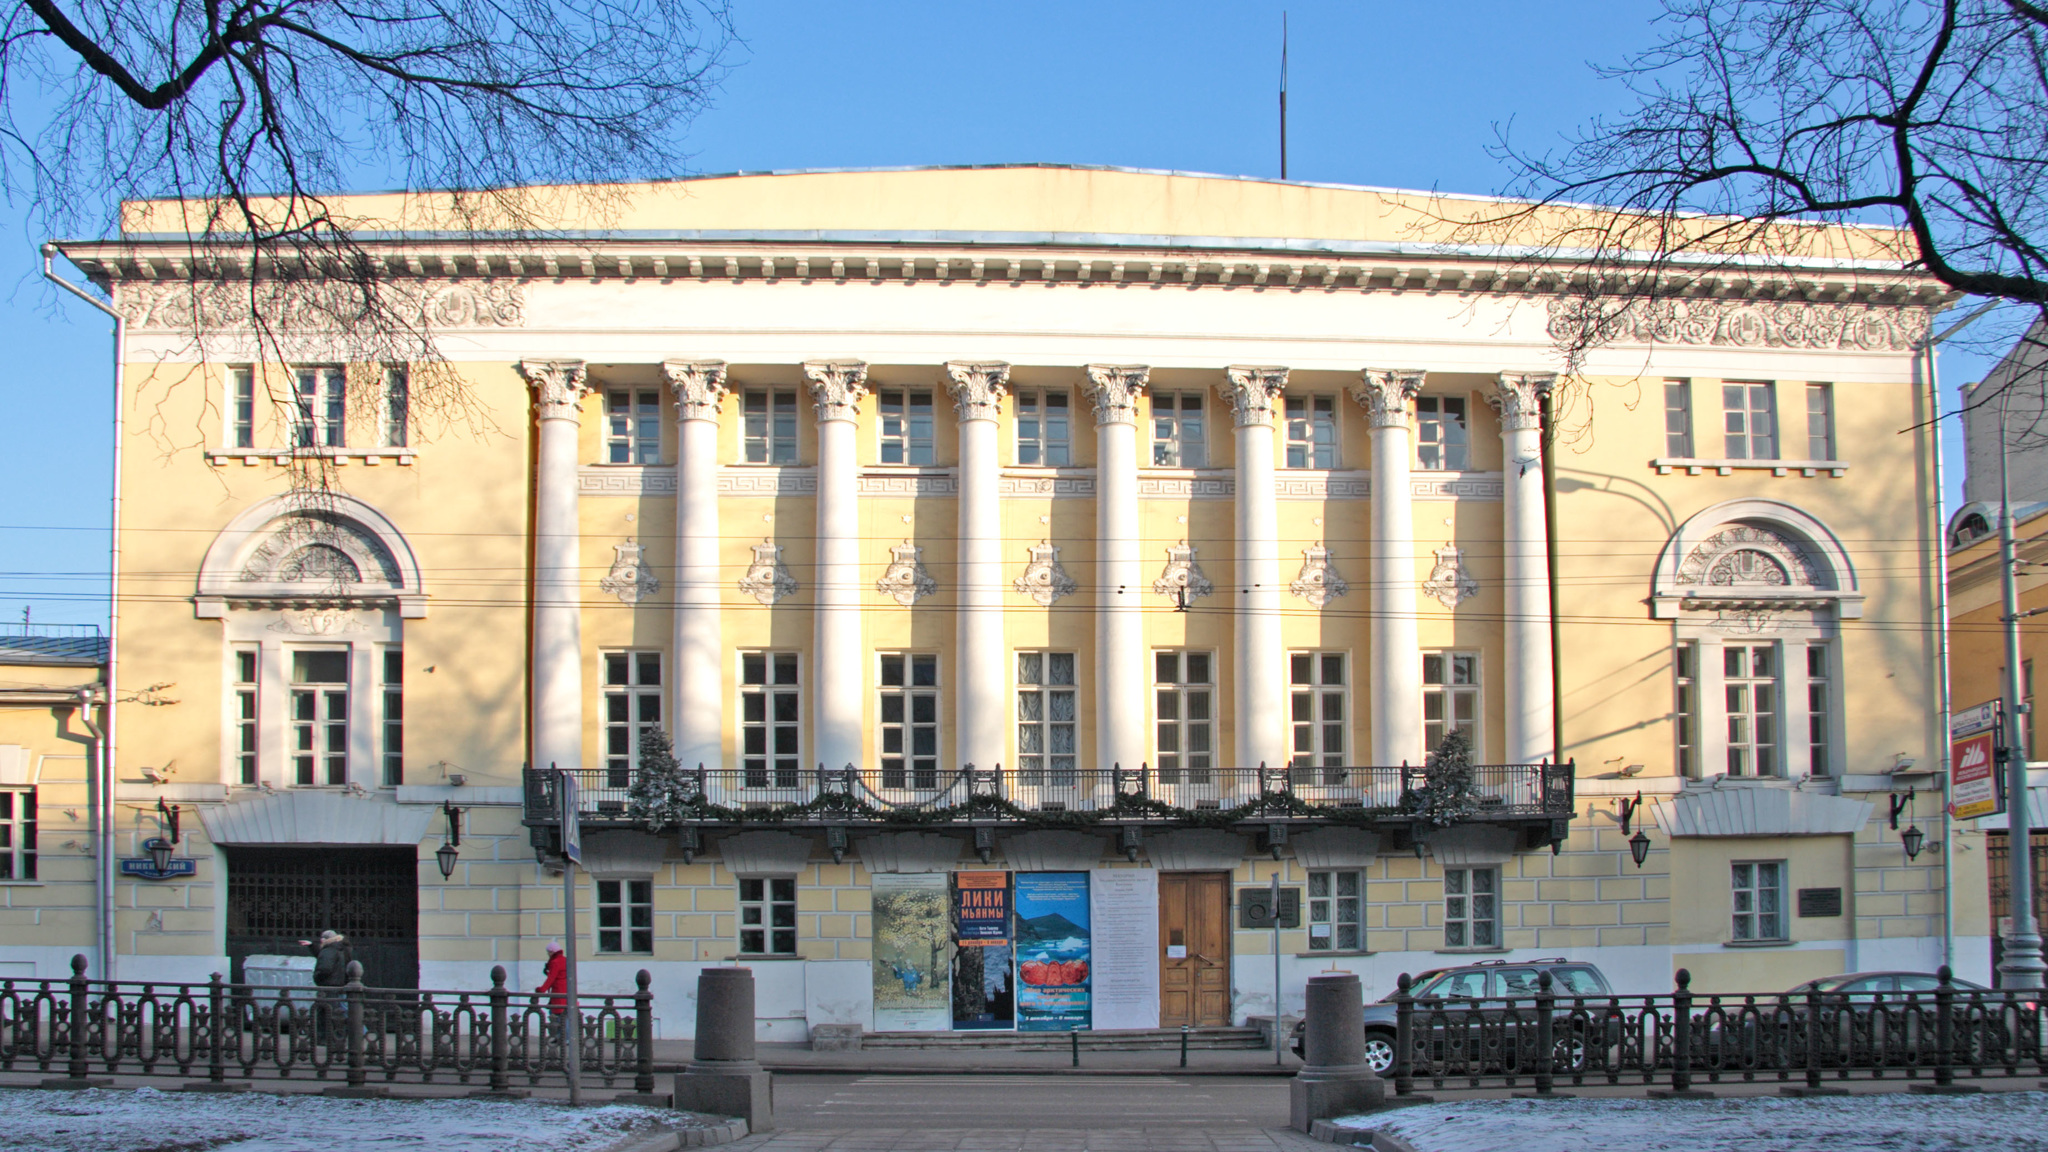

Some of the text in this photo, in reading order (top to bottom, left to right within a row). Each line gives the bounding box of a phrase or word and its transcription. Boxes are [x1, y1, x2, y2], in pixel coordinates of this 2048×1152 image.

[128, 862, 186, 870] НИКИКИЙ
[961, 890, 1003, 907] ЛИКИ
[961, 908, 1003, 919] МЬЯНМЫ
[1030, 1014, 1054, 1022] декабря
